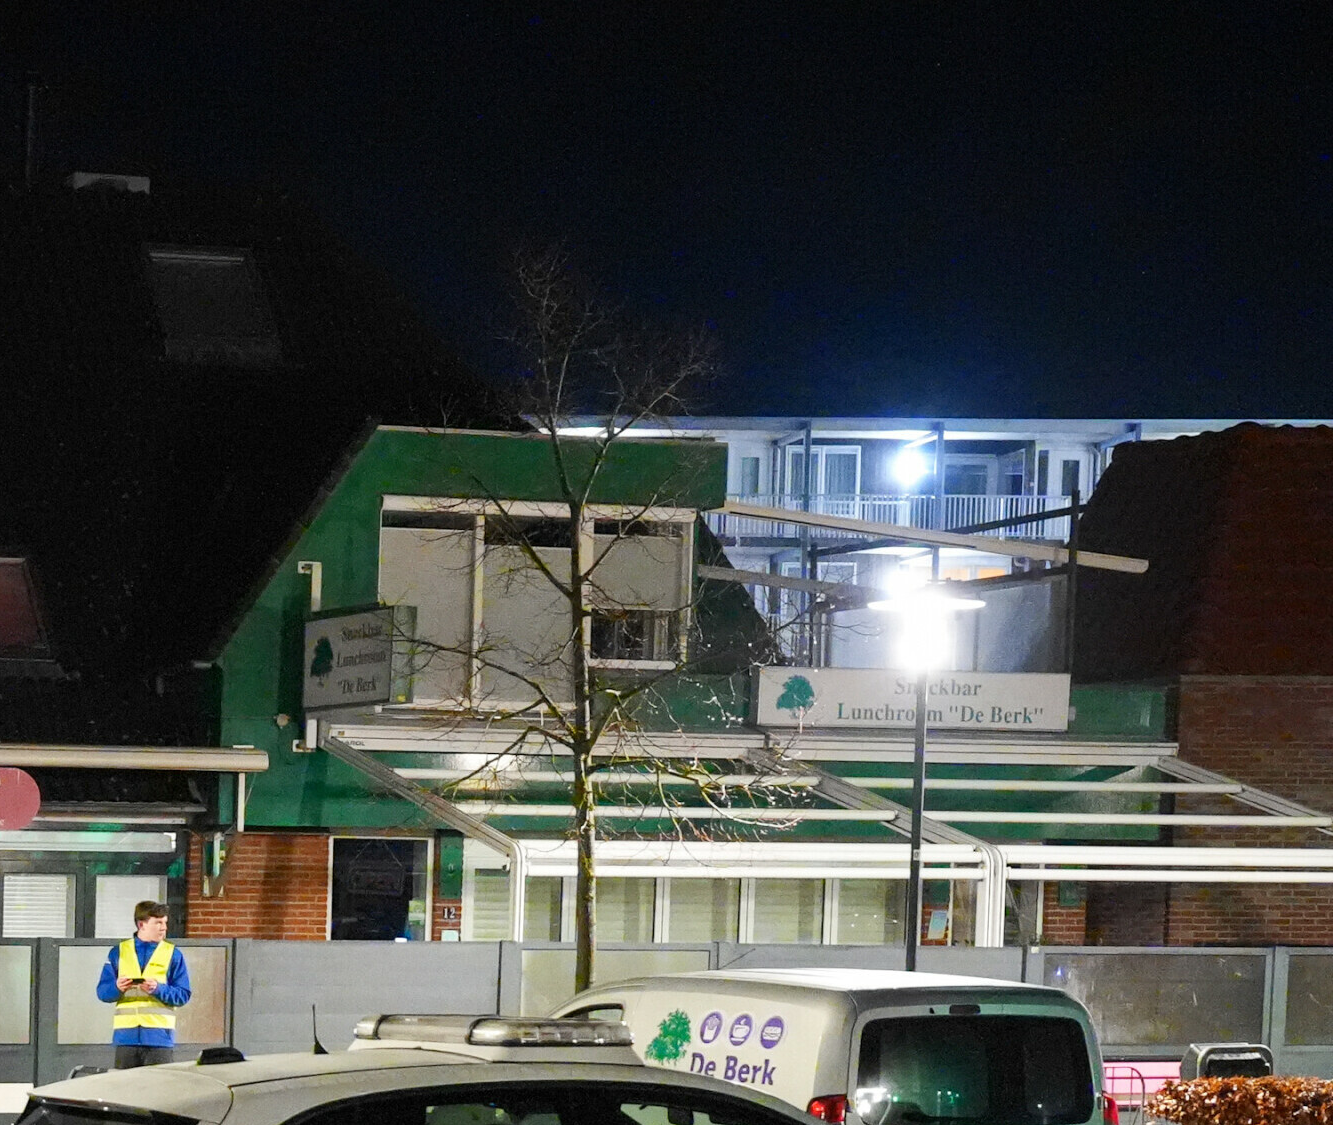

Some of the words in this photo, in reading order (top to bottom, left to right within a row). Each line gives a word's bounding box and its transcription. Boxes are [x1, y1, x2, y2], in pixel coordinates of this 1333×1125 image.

[894, 678, 981, 697] Snckbar
[837, 702, 943, 723] Lunchrom
[949, 706, 984, 724] "De
[991, 706, 1043, 724] Berk"
[443, 907, 456, 919] 12
[690, 1052, 716, 1077] De
[724, 1055, 776, 1085] Berk
